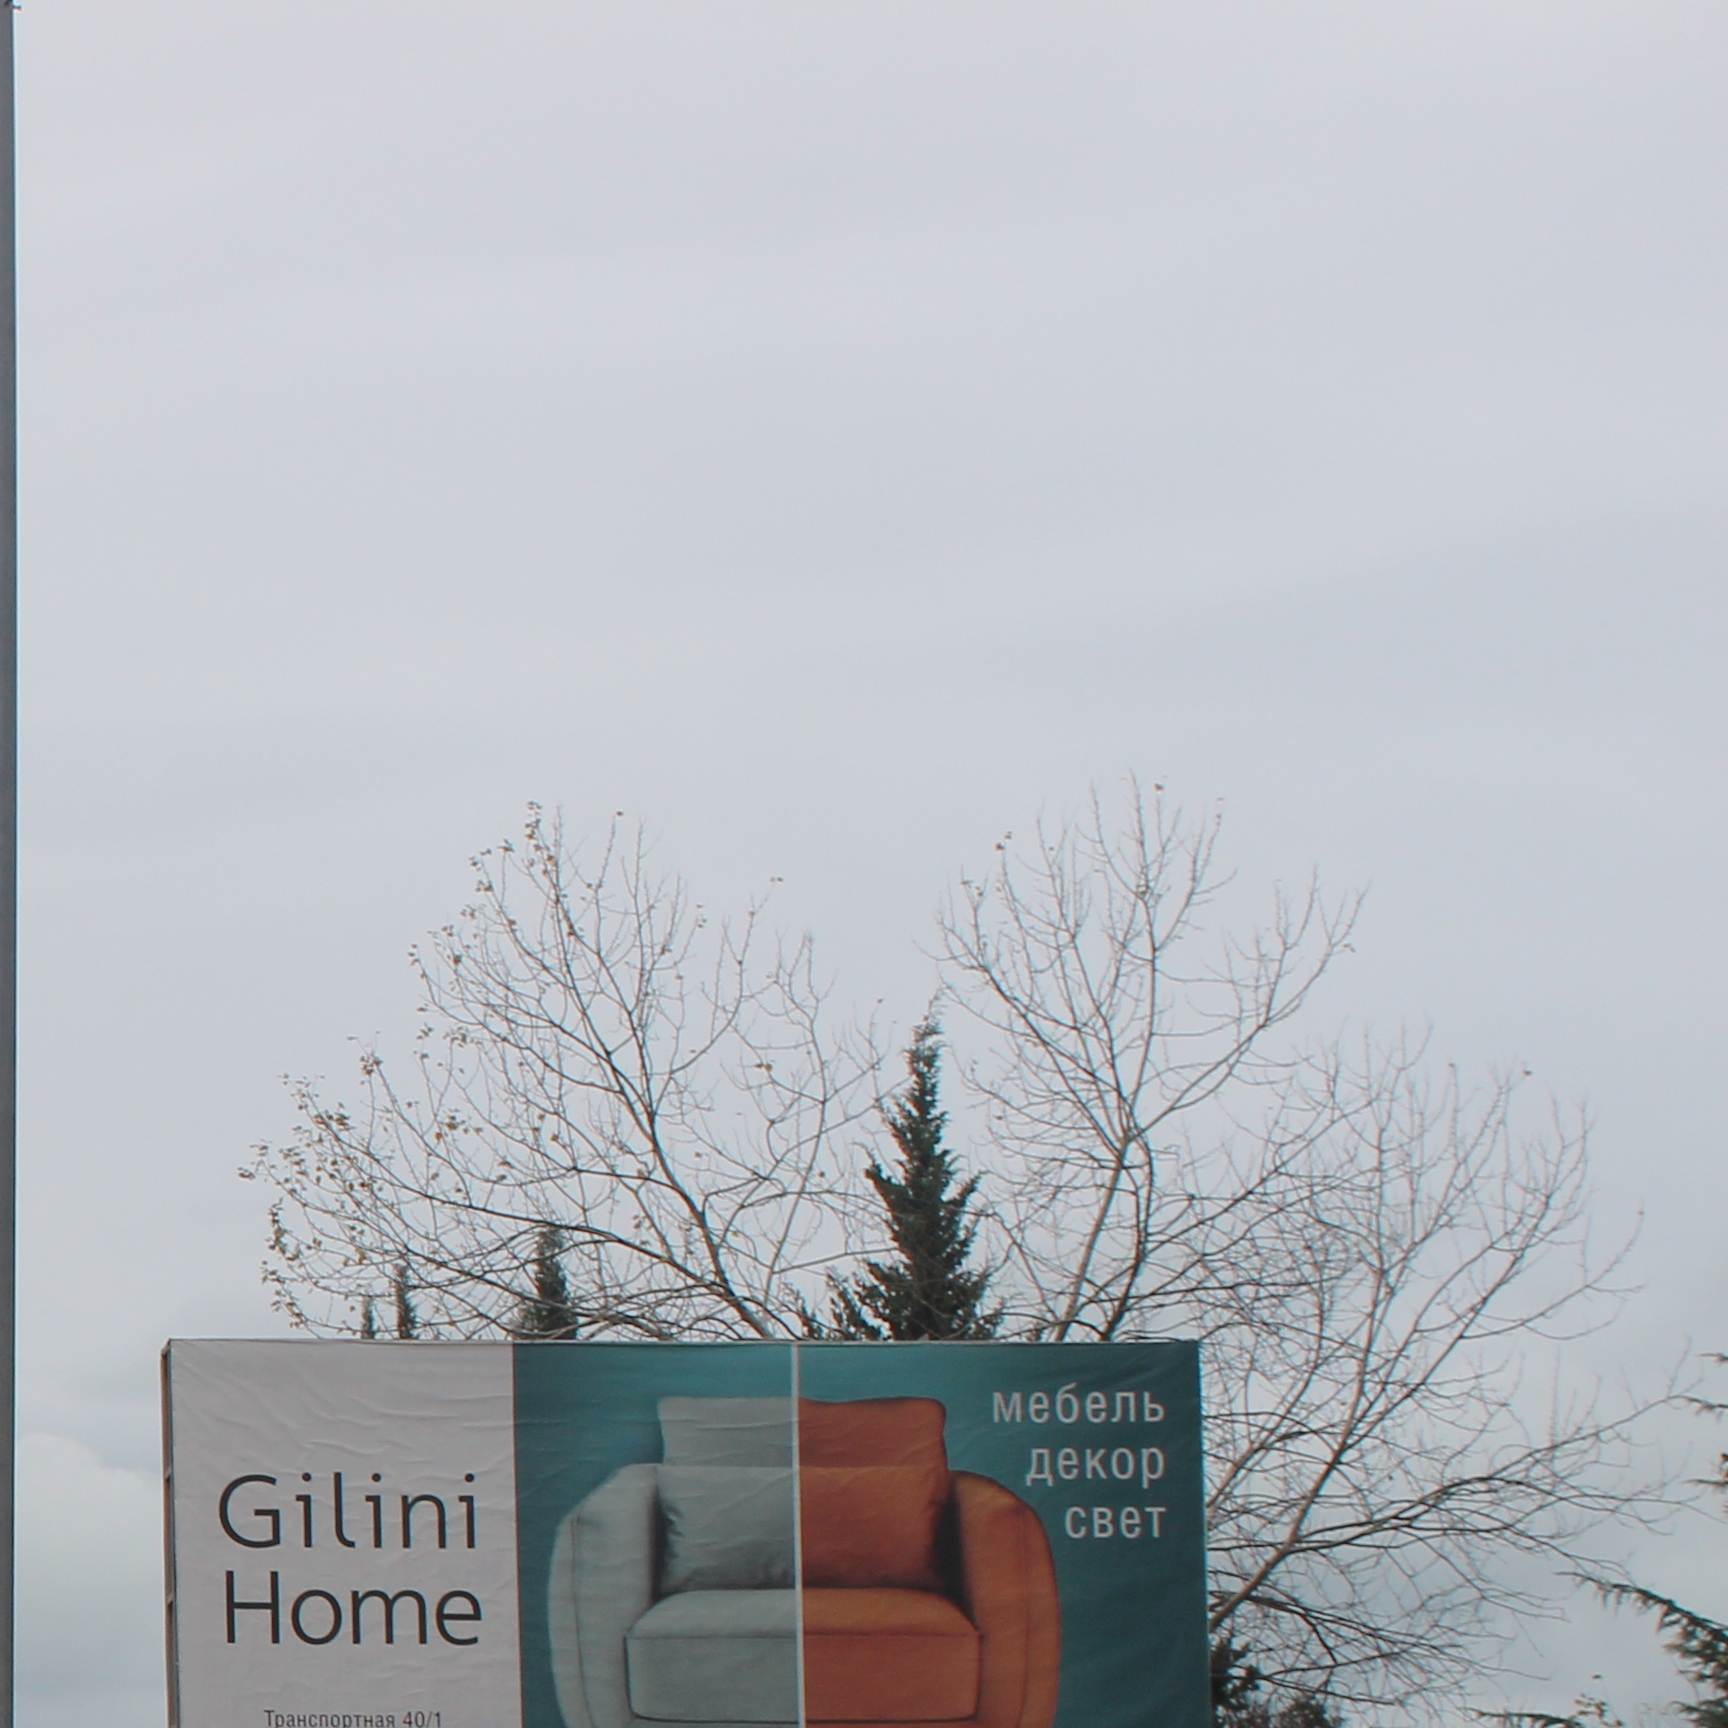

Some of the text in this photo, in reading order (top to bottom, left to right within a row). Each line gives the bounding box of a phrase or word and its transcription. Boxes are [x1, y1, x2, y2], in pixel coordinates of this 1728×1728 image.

[992, 1382, 1165, 1425] мебель
[1024, 1446, 1165, 1490] декор
[218, 1471, 477, 1550] Gilini
[1064, 1505, 1166, 1540] свет
[224, 1569, 483, 1647] Home
